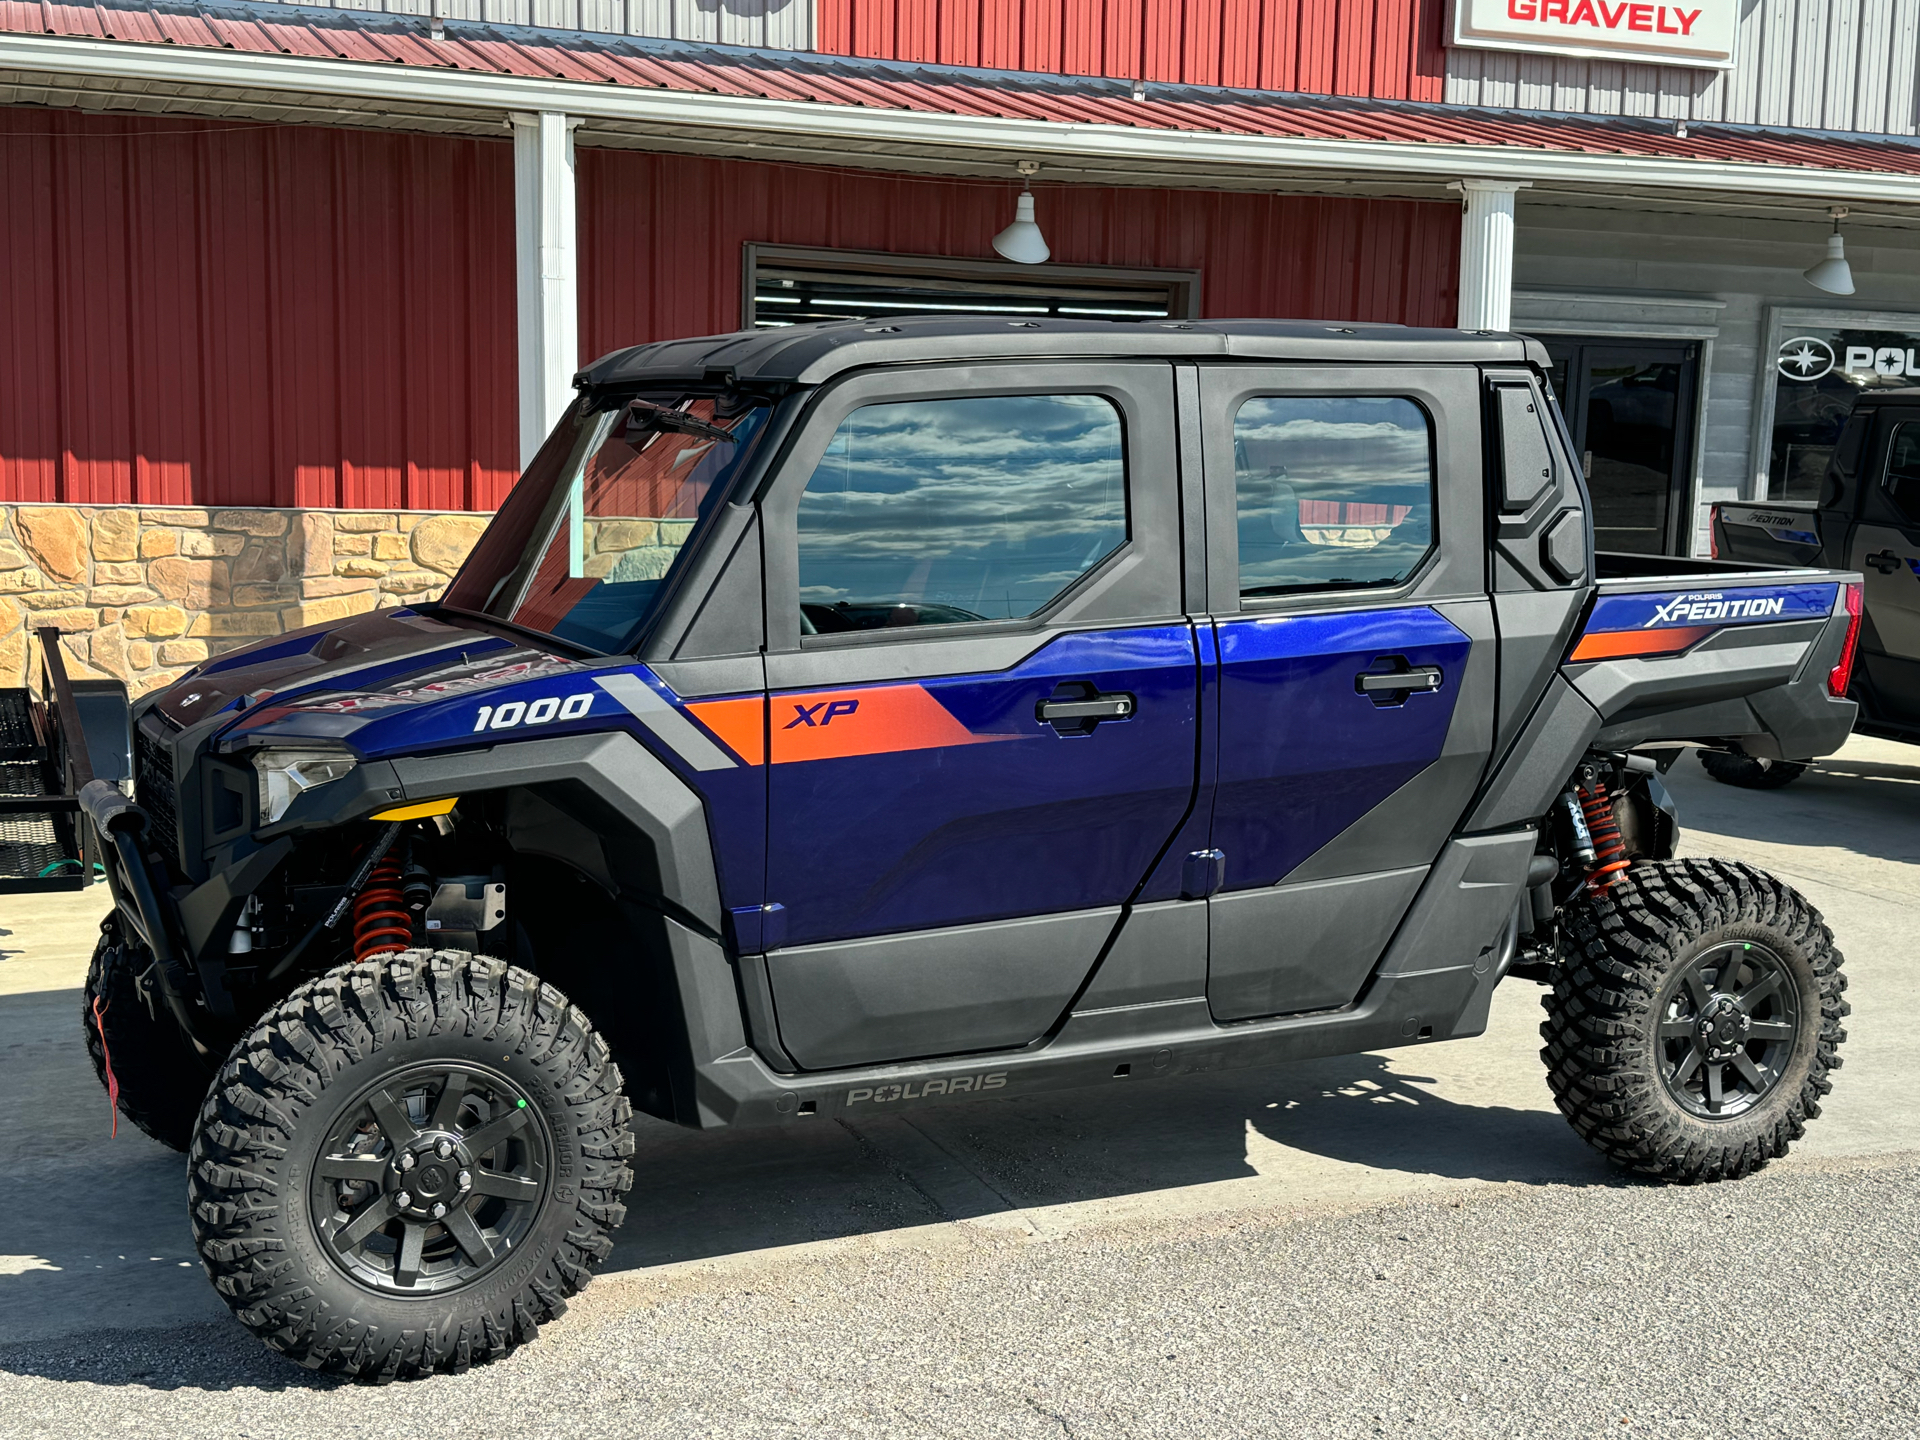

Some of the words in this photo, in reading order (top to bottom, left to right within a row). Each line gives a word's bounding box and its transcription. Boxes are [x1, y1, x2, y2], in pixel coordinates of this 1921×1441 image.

[1507, 0, 1703, 36] GRAVELY
[1643, 595, 1784, 628] XPEDITION
[1688, 593, 1723, 601] POLARIS
[473, 692, 595, 732] 1000
[782, 699, 859, 730] XP
[846, 1071, 1008, 1107] POLARIS
[549, 1111, 574, 1178] ARMOR
